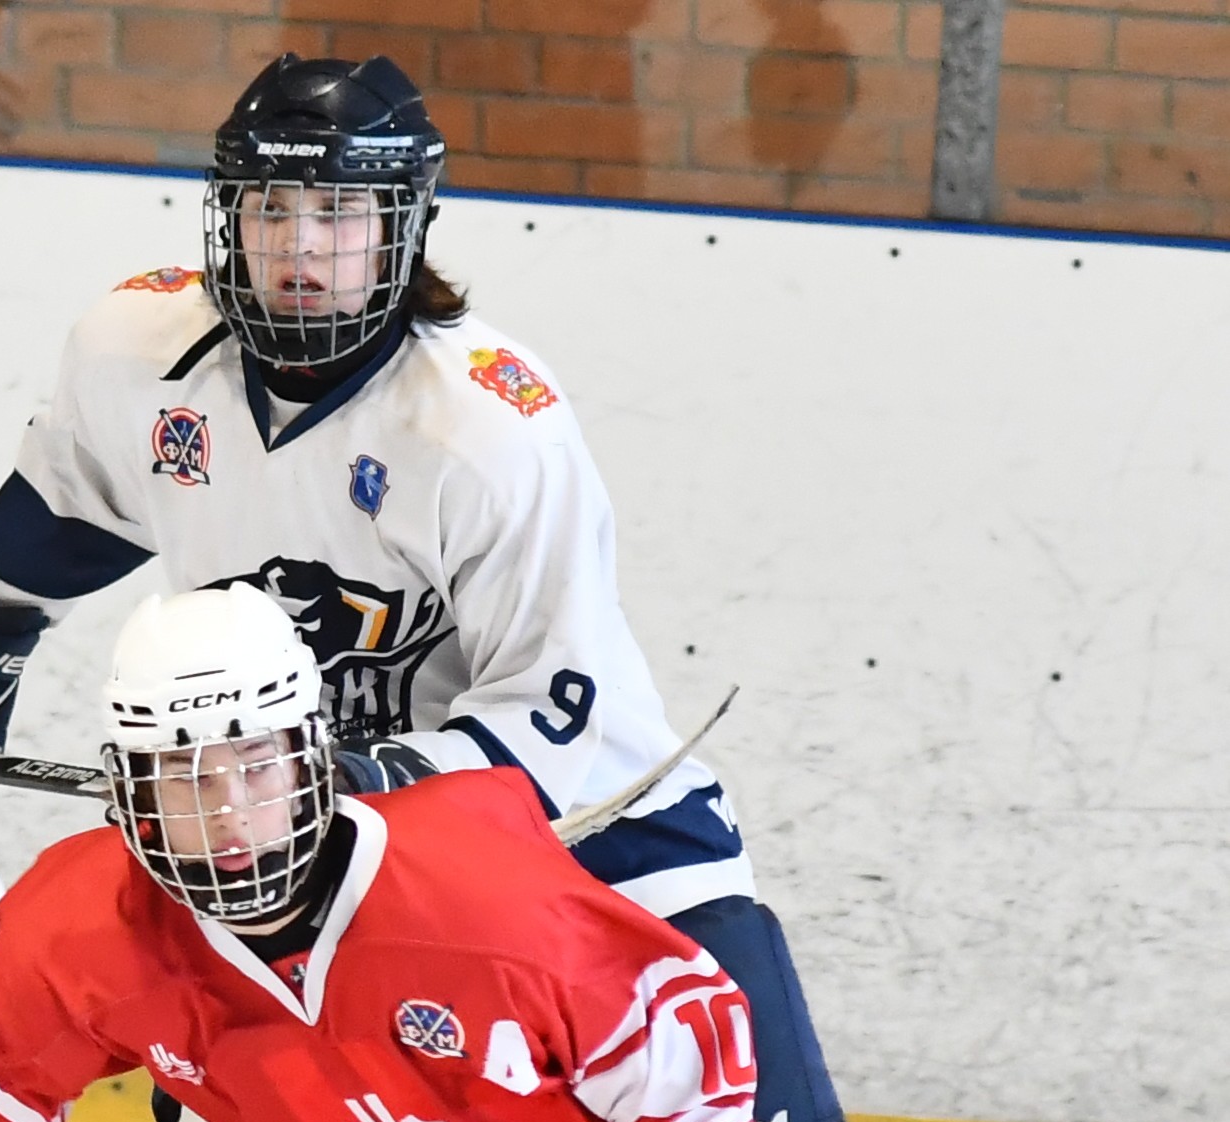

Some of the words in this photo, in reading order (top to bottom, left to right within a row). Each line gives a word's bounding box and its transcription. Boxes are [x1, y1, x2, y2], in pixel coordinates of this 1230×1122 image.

[257, 142, 327, 157] BAUER
[163, 442, 202, 469] ФХМ
[169, 689, 241, 712] CCM
[530, 668, 597, 745] 9
[481, 1019, 541, 1096] A
[674, 992, 755, 1095] 10
